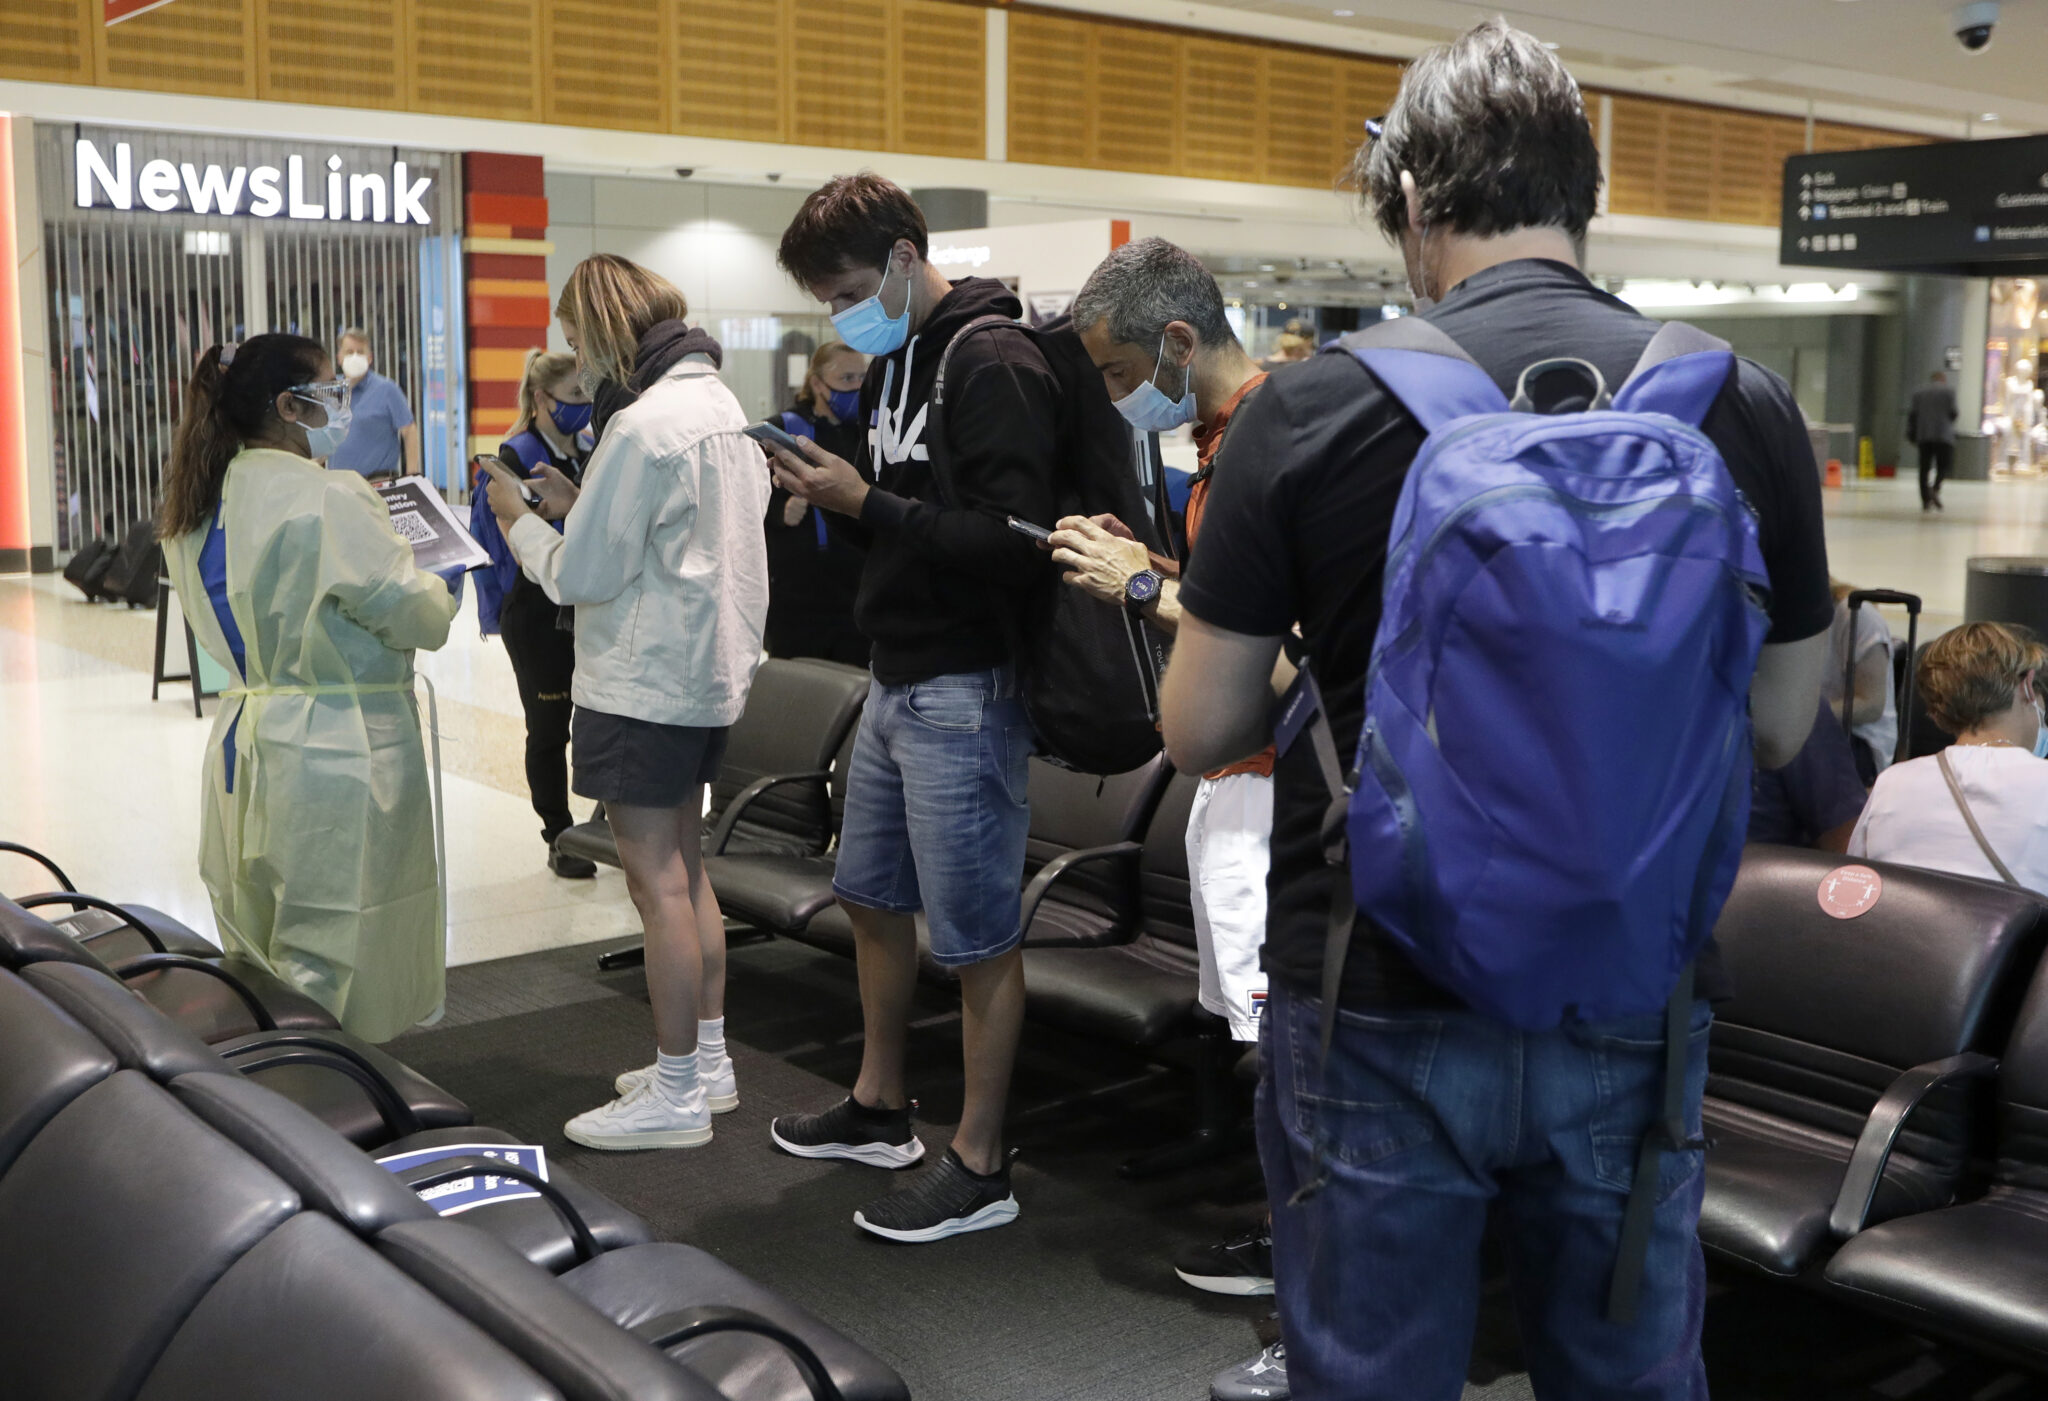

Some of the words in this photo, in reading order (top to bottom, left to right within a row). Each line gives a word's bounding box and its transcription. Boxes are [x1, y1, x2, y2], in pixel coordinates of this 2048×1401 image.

[75, 139, 432, 225] NewsLink
[385, 493, 408, 503] ntry
[1251, 1388, 1270, 1397] FILA
